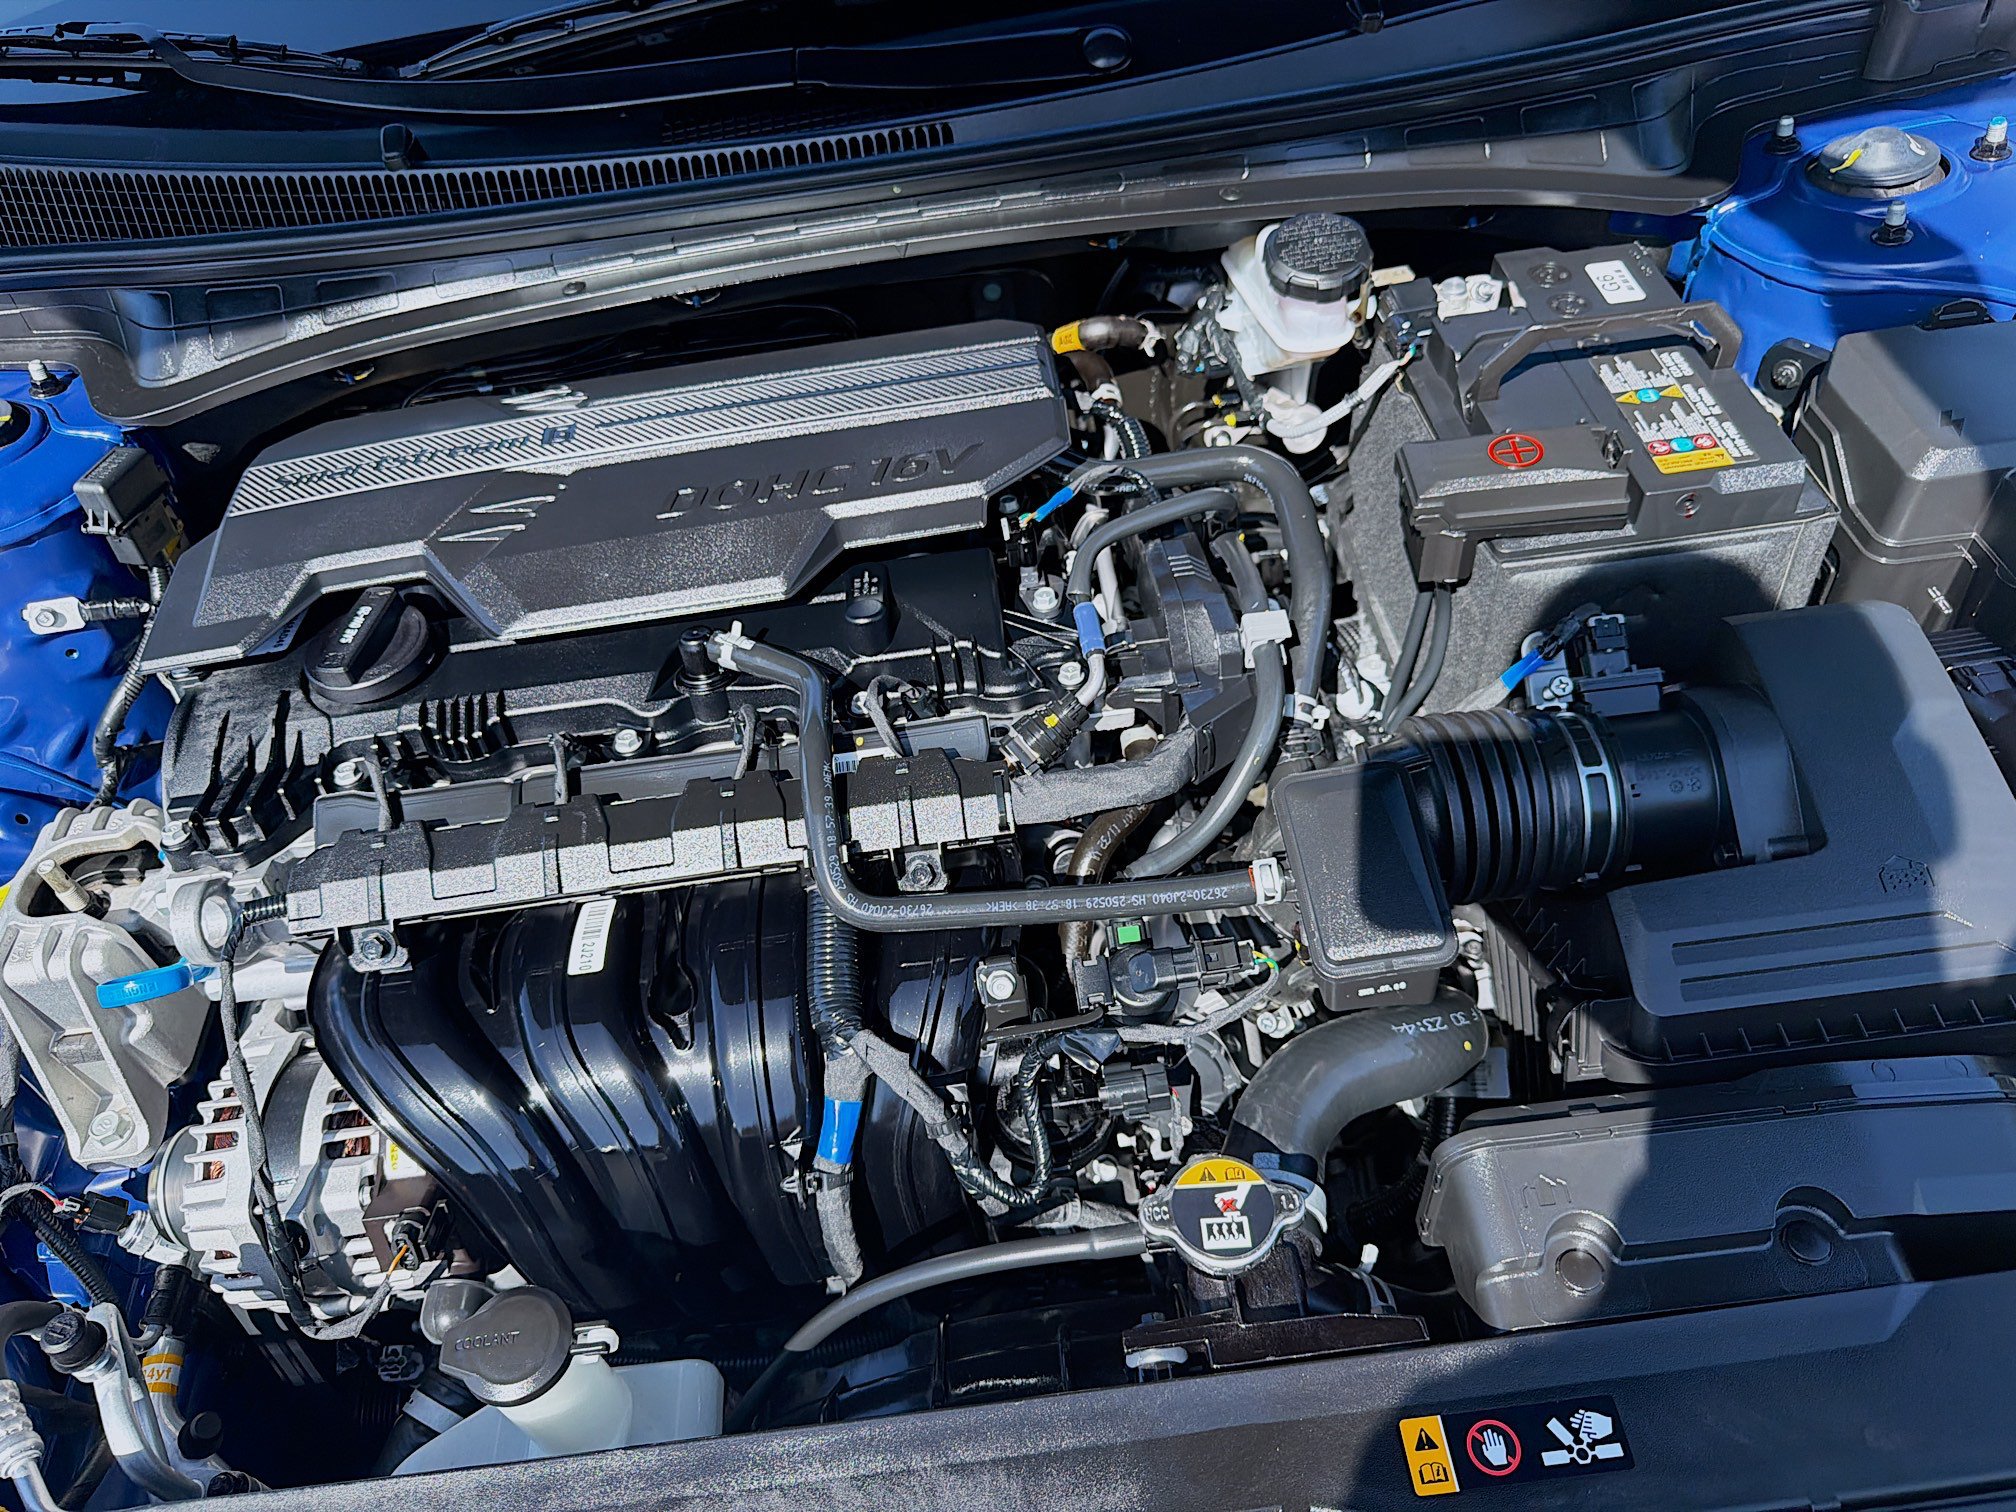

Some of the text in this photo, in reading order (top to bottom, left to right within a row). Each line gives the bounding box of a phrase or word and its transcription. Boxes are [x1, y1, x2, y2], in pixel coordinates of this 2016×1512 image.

[656, 440, 984, 519] DOHC 16V
[828, 855, 848, 891] 250529
[844, 892, 859, 907] HS
[1086, 896, 1126, 910] 250529
[1132, 894, 1147, 907] HS
[1151, 886, 1229, 906] 26730-2J040
[861, 901, 933, 918] 26730-2J040
[579, 941, 596, 971] 2J210
[1143, 1204, 1170, 1221] HCC
[455, 1331, 520, 1351] COOLANT
[143, 1366, 172, 1381] 4yf
